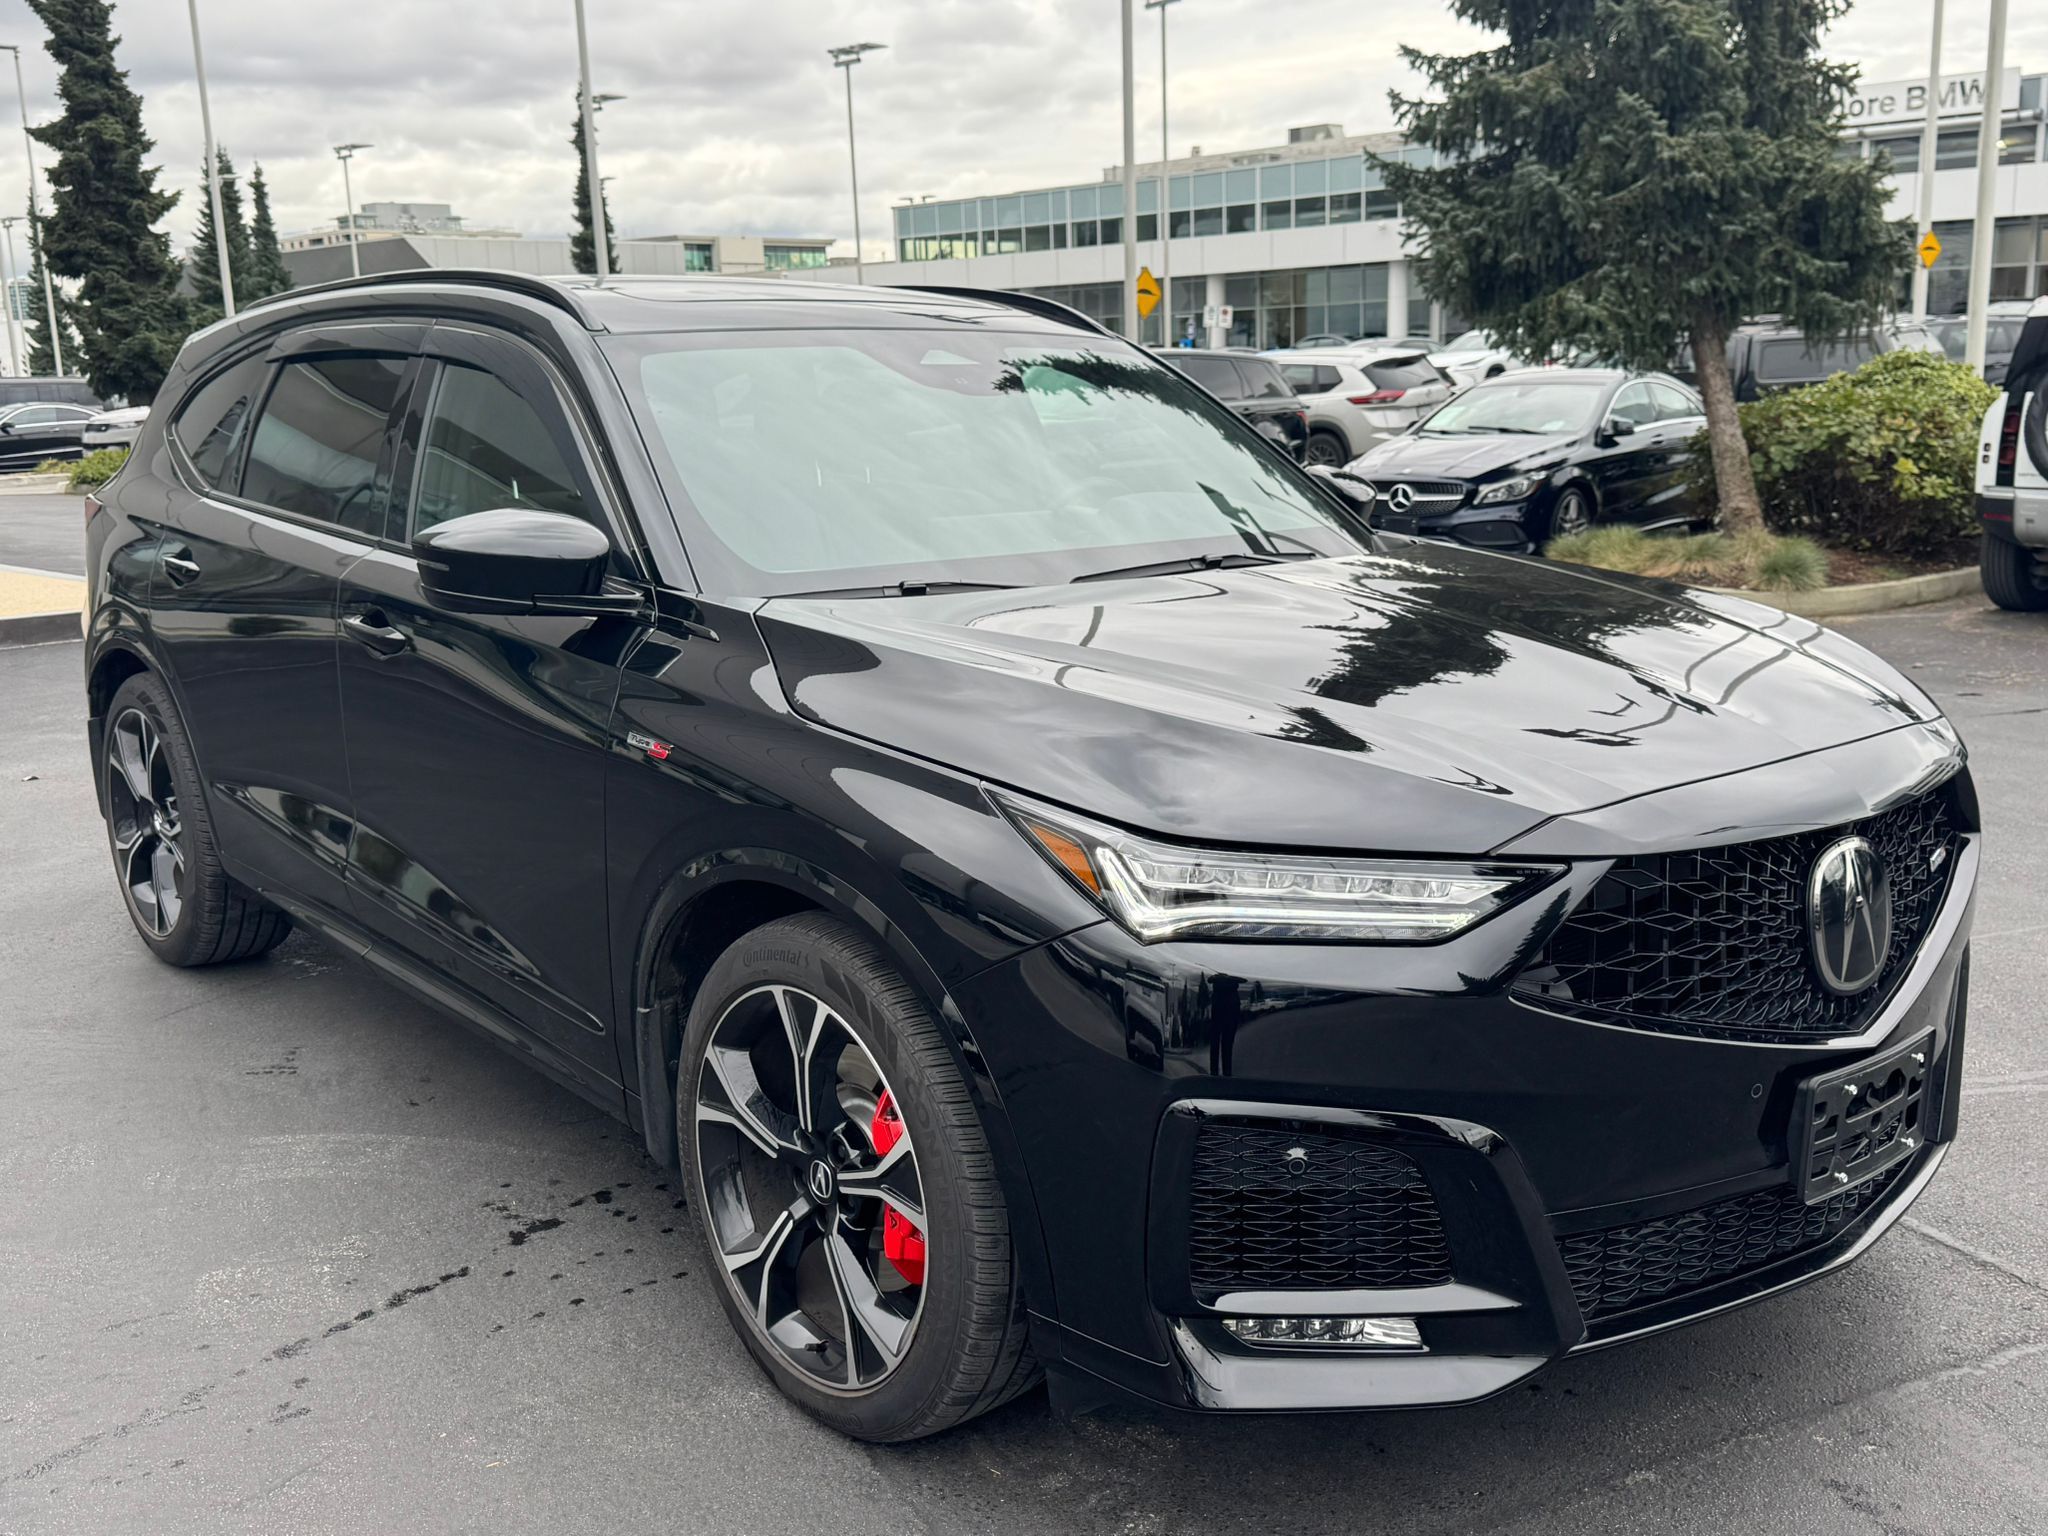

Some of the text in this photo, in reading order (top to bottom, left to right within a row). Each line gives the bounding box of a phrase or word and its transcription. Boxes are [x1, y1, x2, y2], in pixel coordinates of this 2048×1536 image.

[1849, 79, 1986, 117] ore BMW
[630, 733, 651, 748] Type
[743, 946, 802, 968] Continental
